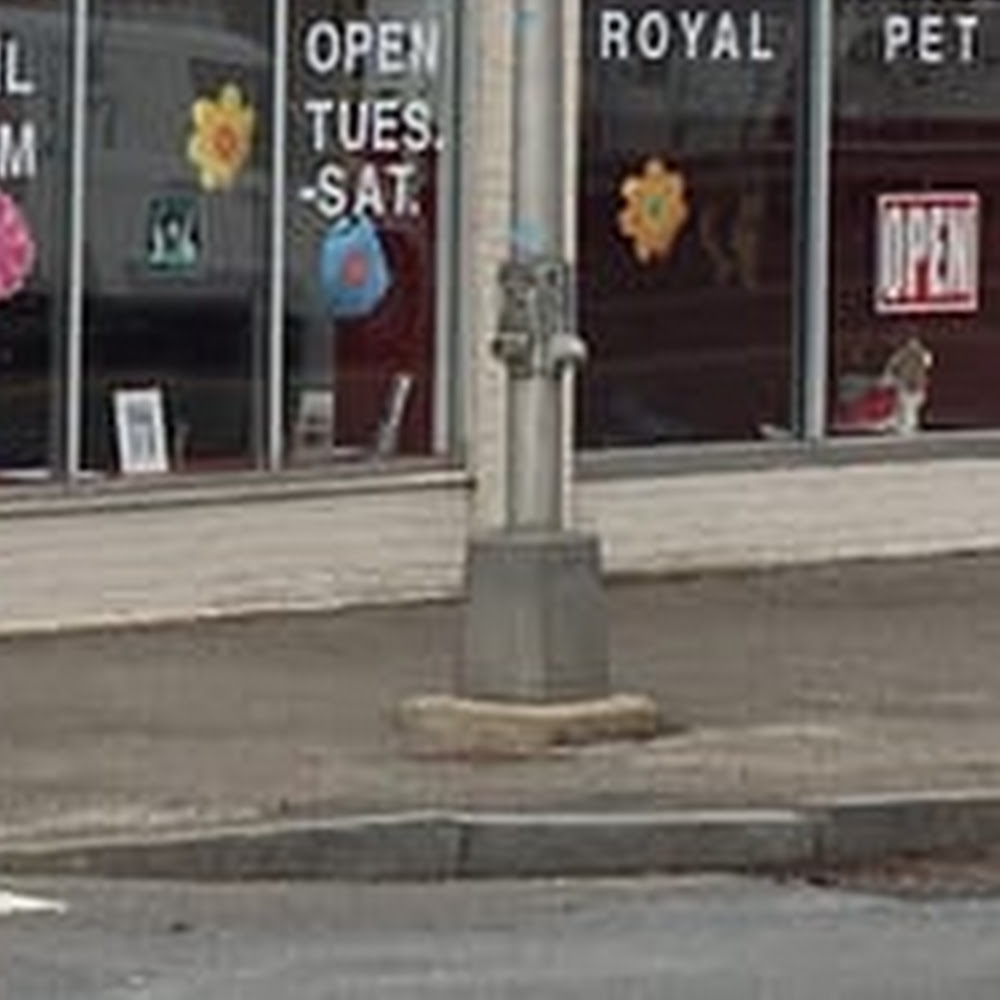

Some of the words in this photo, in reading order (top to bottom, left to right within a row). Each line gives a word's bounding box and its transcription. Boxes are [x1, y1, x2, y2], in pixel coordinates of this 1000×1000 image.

[305, 20, 440, 75] OPEN
[600, 10, 775, 62] ROYAL
[884, 14, 980, 63] PET
[304, 101, 445, 153] TUES.
[878, 205, 978, 301] OPEN
